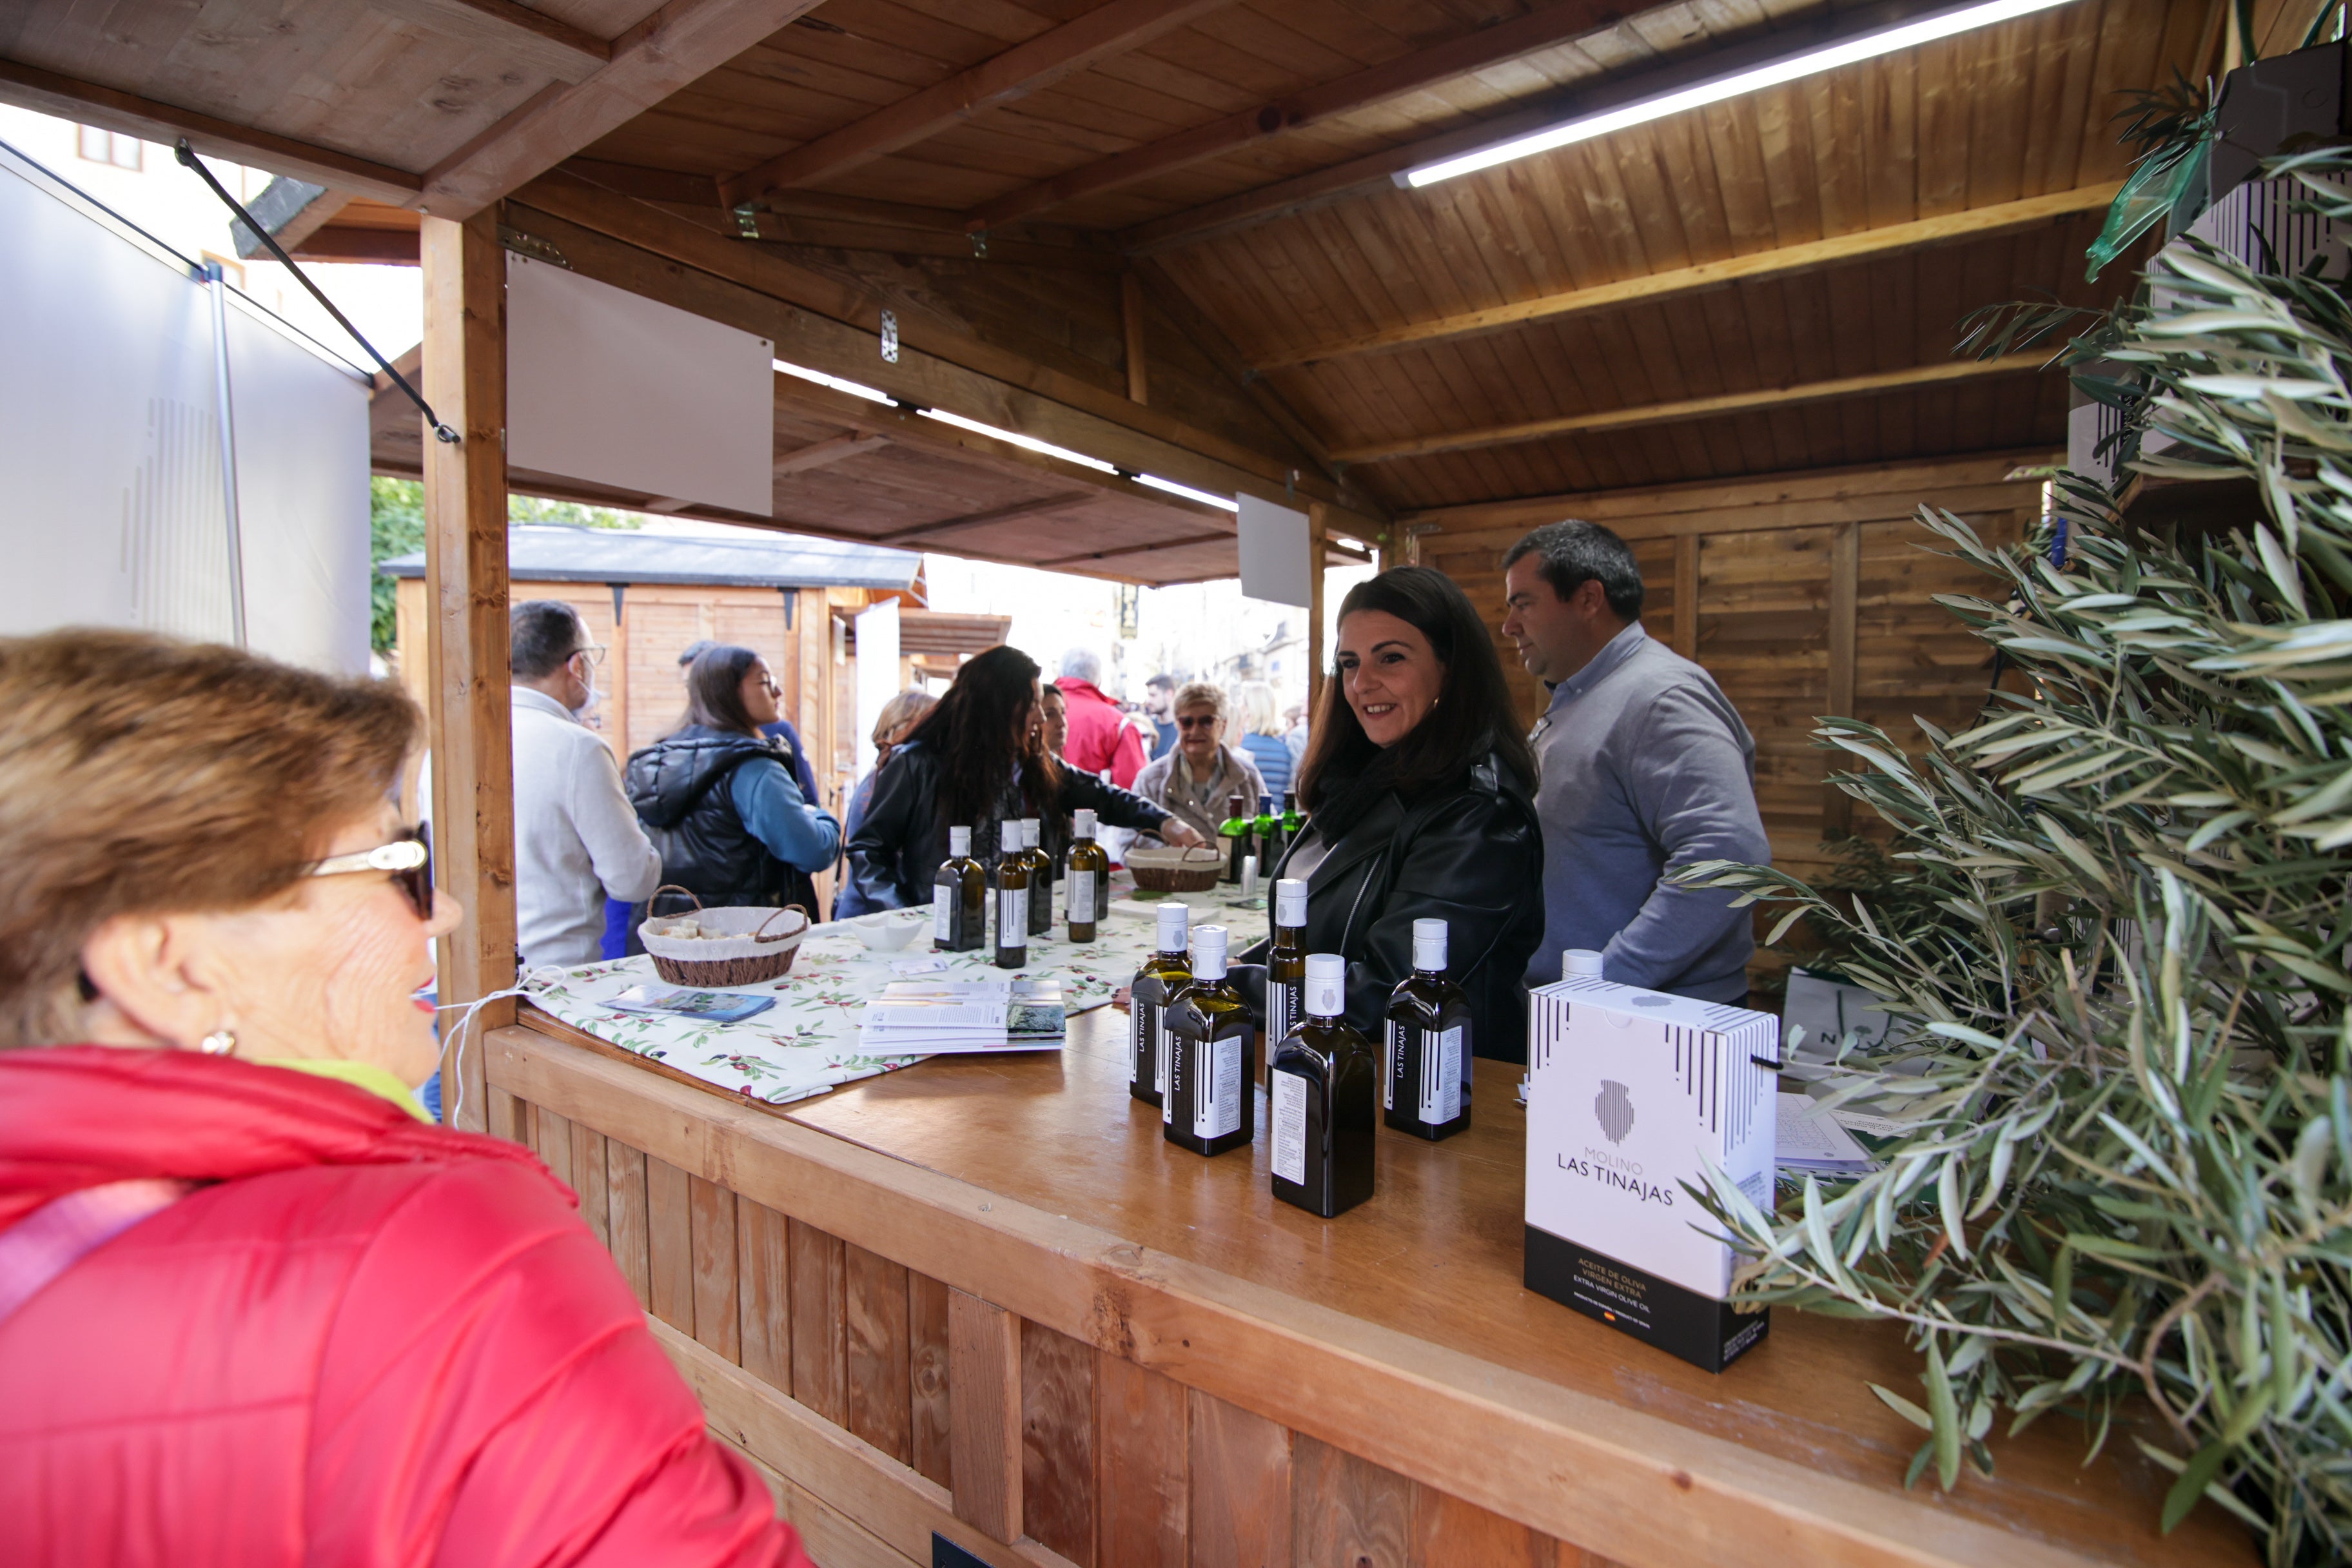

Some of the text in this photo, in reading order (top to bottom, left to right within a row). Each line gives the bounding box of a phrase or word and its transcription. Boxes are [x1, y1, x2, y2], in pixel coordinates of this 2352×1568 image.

[1289, 986, 1298, 1020] TINAJAS
[1174, 1035, 1182, 1073] TINAJAS
[1397, 1025, 1406, 1060] TINAJAS
[1585, 1147, 1643, 1175] MOLINO
[1558, 1153, 1673, 1206] LAS TINAJAS
[1578, 1258, 1647, 1291] ACEITE DE OLIVA
[1582, 1268, 1642, 1299] VIRGEN EXTRA
[1574, 1274, 1651, 1314] EXTRA VIRGIN OLIVE OIL
